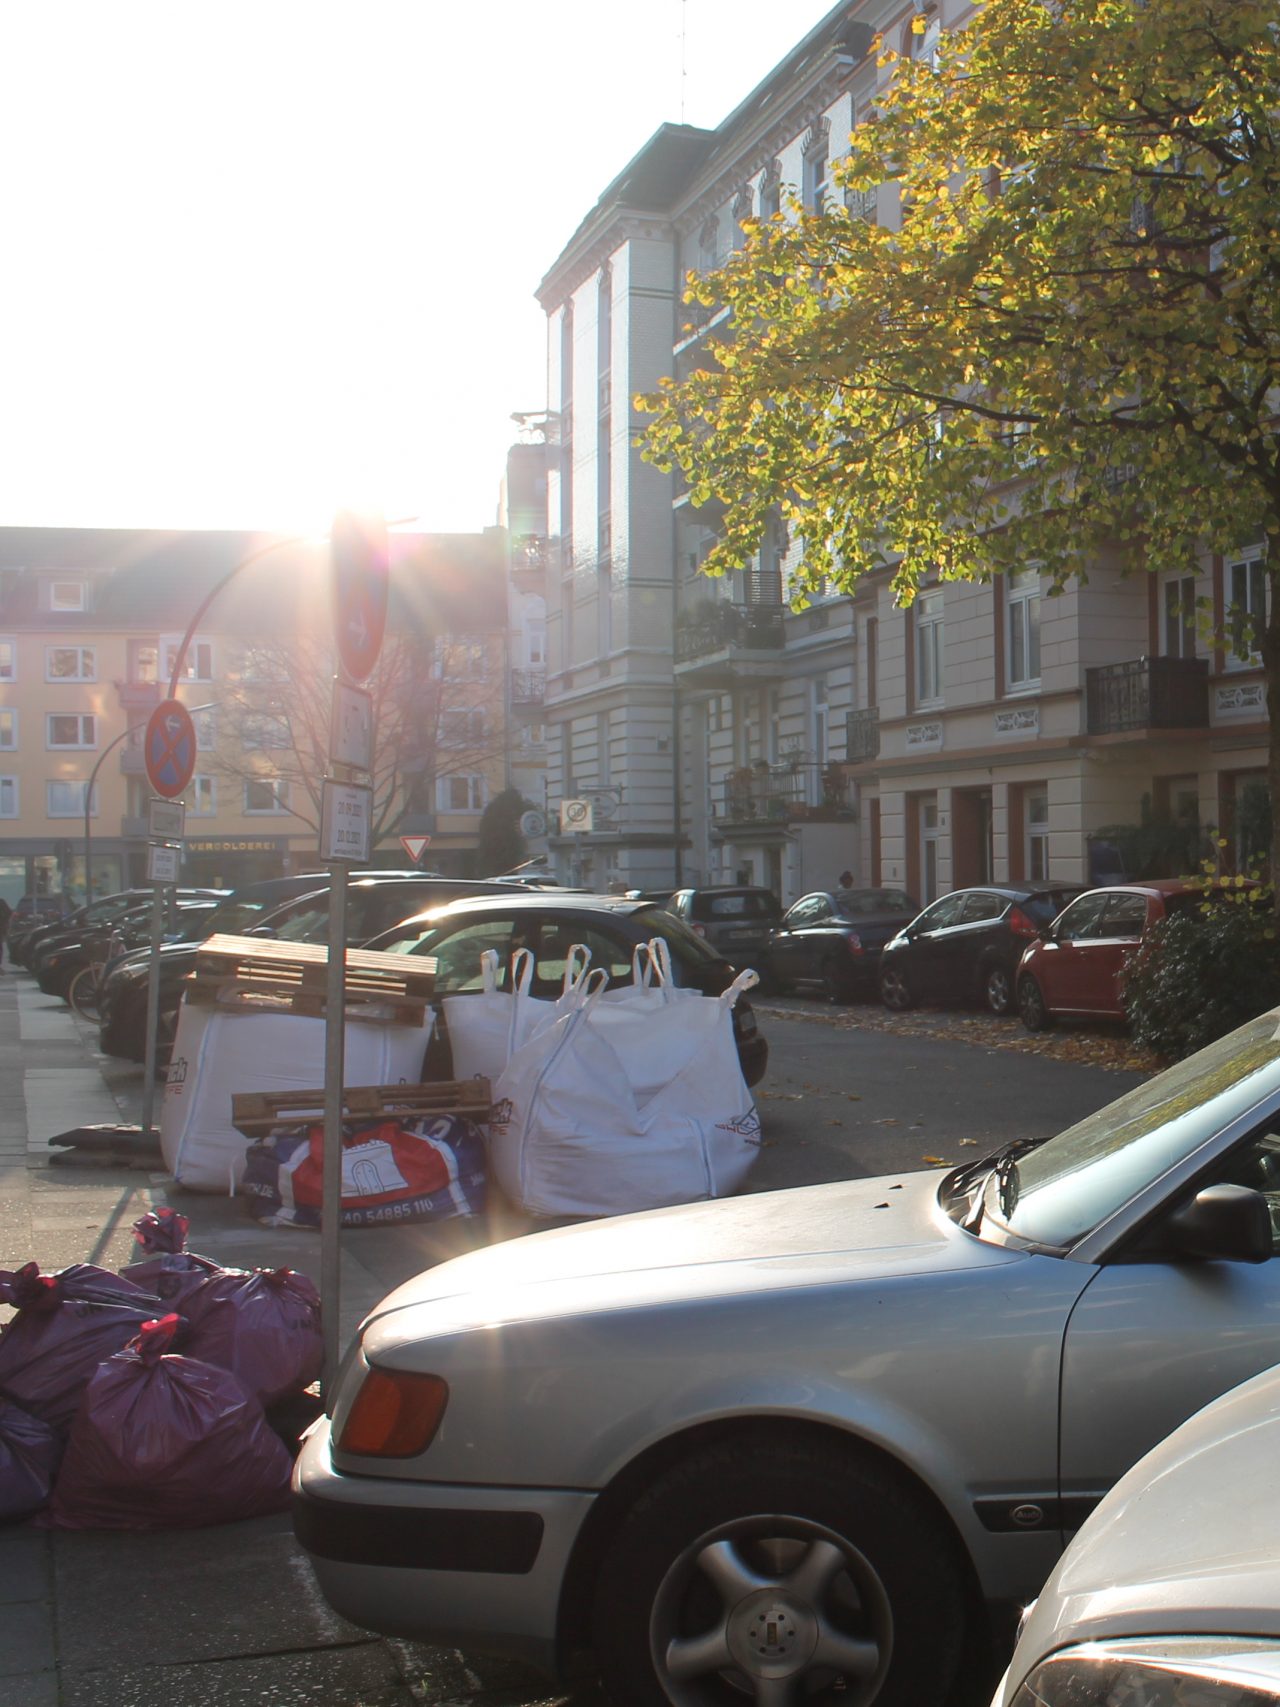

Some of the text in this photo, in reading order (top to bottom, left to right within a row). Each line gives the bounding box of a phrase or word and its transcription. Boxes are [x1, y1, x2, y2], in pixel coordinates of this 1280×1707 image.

[570, 806, 585, 818] 30
[366, 1203, 411, 1223] 54885
[413, 1198, 433, 1215] 110
